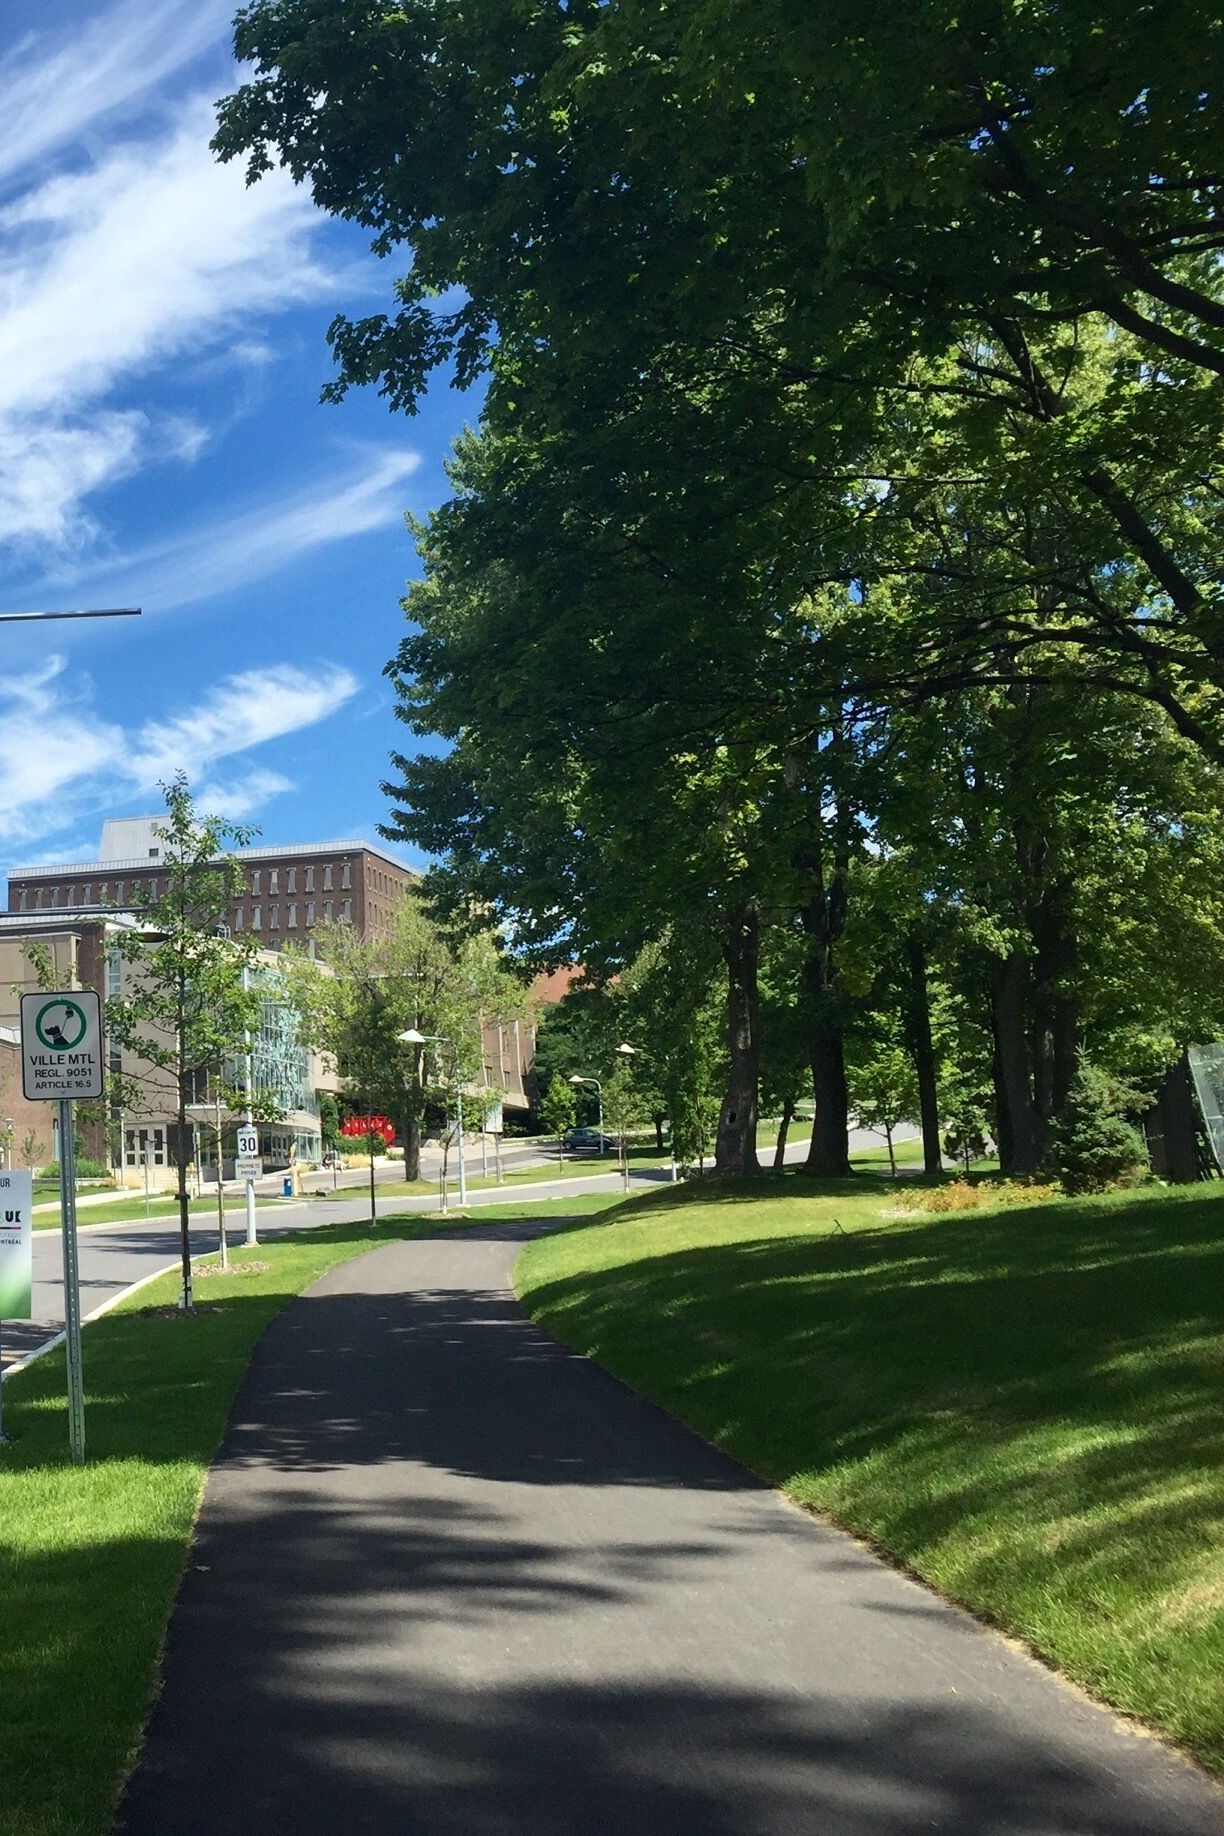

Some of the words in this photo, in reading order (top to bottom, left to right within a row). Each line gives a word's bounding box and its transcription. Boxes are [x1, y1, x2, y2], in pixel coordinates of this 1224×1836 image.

[30, 1055, 65, 1066] VILLE
[68, 1053, 95, 1064] MTL
[34, 1069, 65, 1078] REGL.
[66, 1068, 92, 1077] 9051
[35, 1081, 73, 1089] ARTICLE
[75, 1080, 92, 1088] 16.5
[239, 1137, 256, 1152] 30
